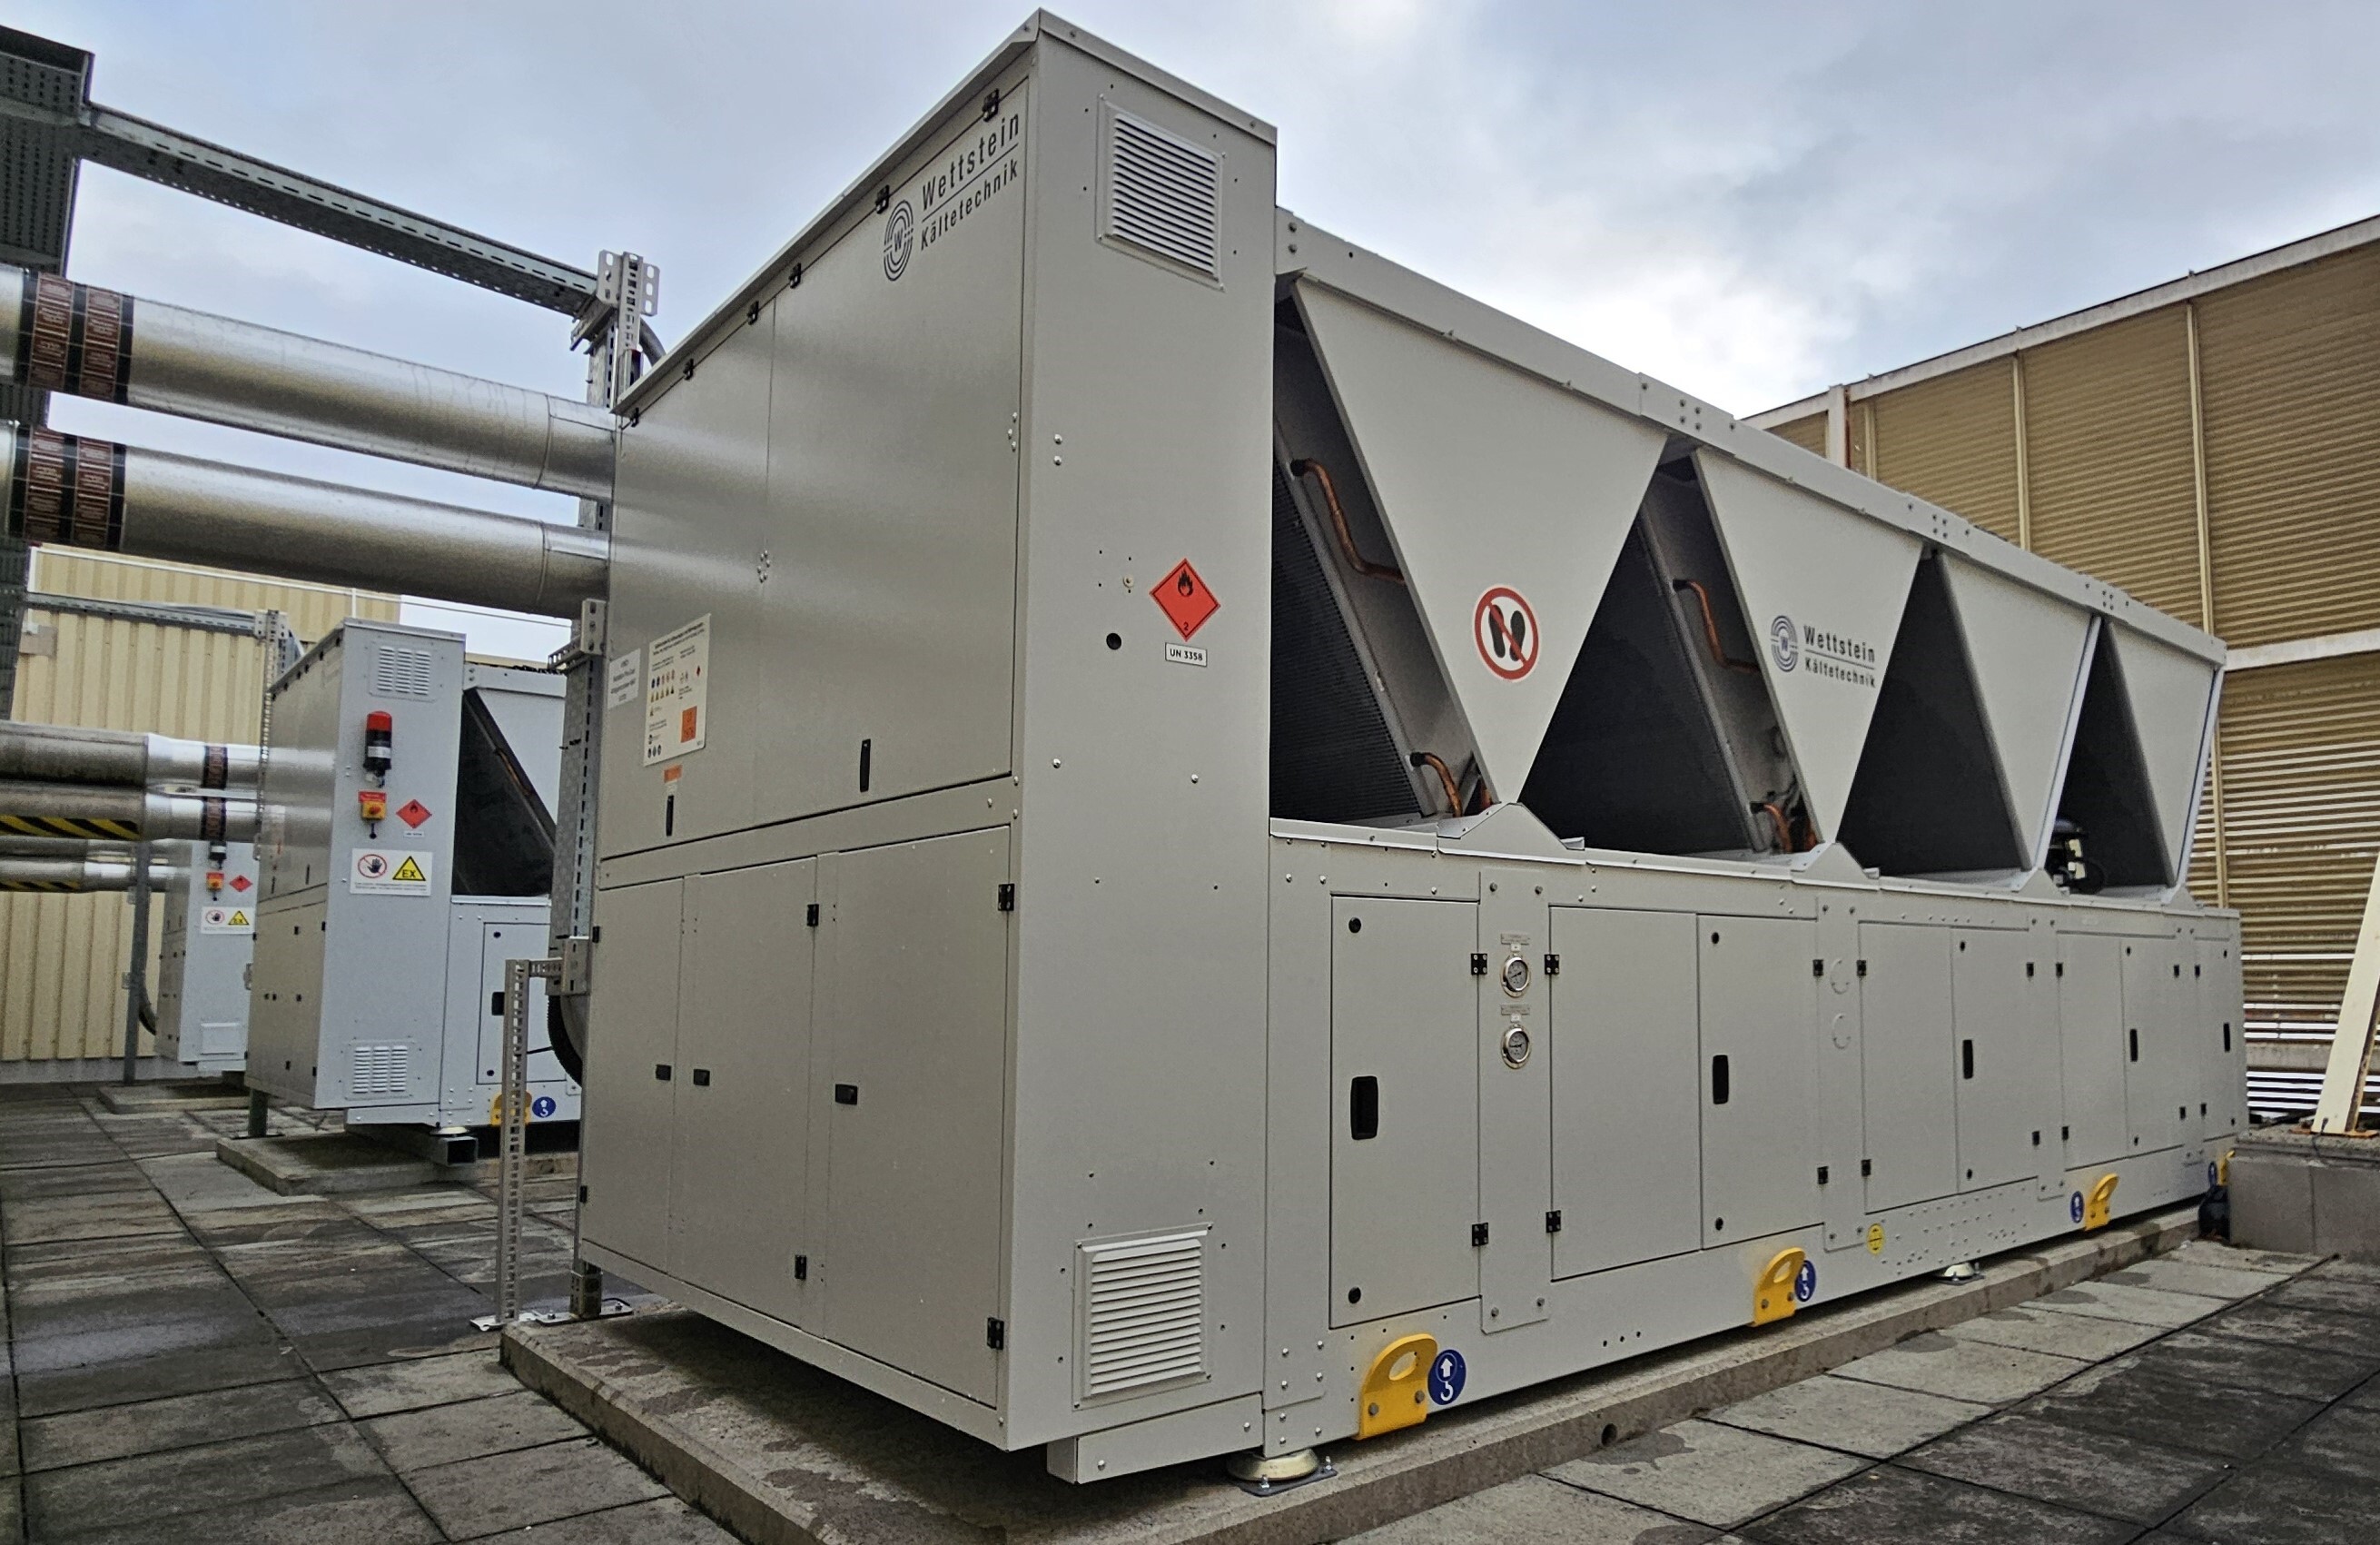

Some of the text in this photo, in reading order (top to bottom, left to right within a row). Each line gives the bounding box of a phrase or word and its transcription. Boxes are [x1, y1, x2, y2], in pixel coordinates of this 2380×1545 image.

[921, 113, 1019, 212] Wettstein
[921, 158, 1019, 251] Kältetechnik
[1182, 621, 1190, 631] 2
[1170, 649, 1203, 661] UN 3358
[1803, 625, 1875, 663] Wettstein
[1804, 657, 1876, 688] Kältetechnik
[401, 869, 417, 878] EX
